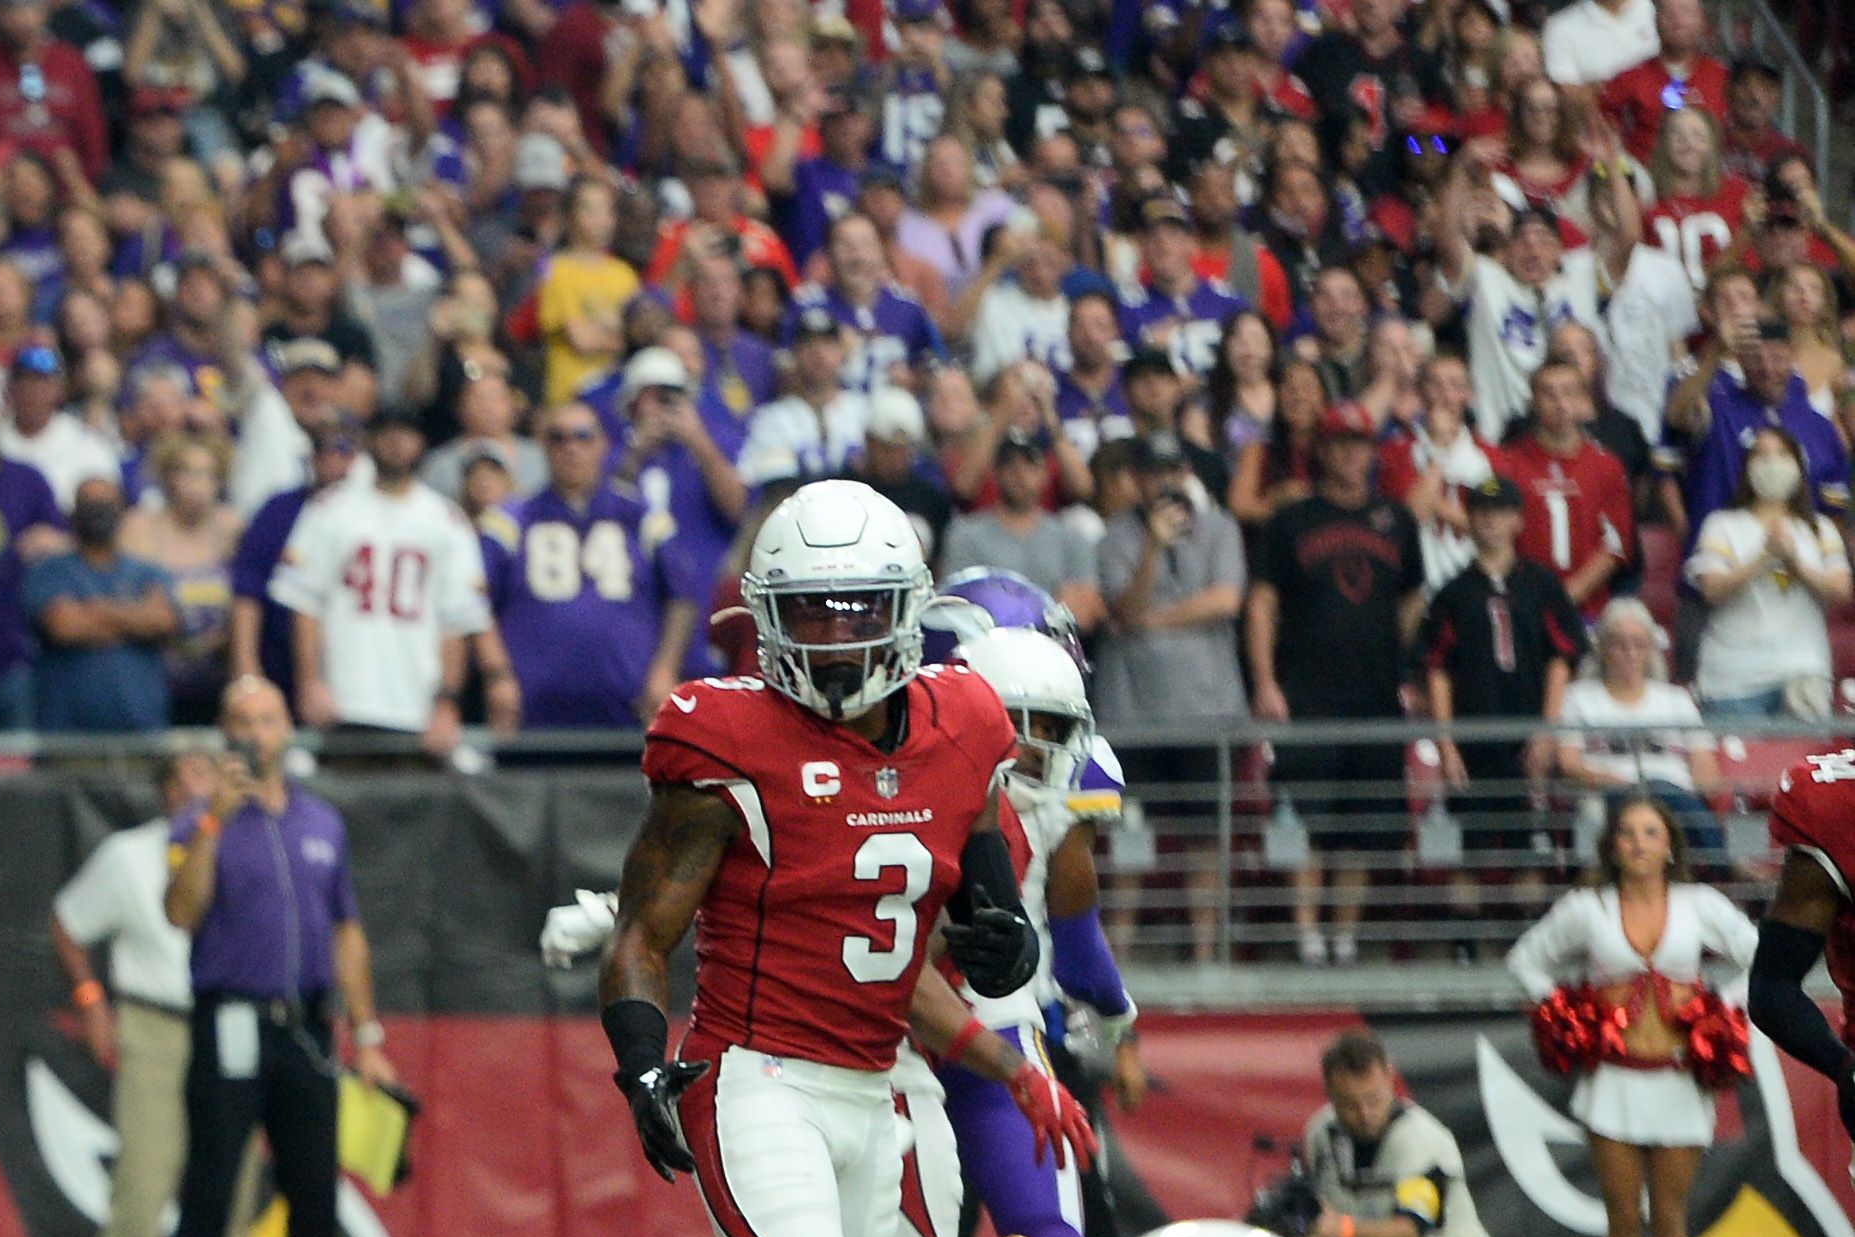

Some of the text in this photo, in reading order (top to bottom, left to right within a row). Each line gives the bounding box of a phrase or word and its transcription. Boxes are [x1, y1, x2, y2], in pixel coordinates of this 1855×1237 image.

[343, 546, 429, 620] 40
[526, 520, 632, 601] 84
[801, 761, 841, 797] C
[846, 808, 933, 827] CARDINALS
[842, 833, 933, 983] 3
